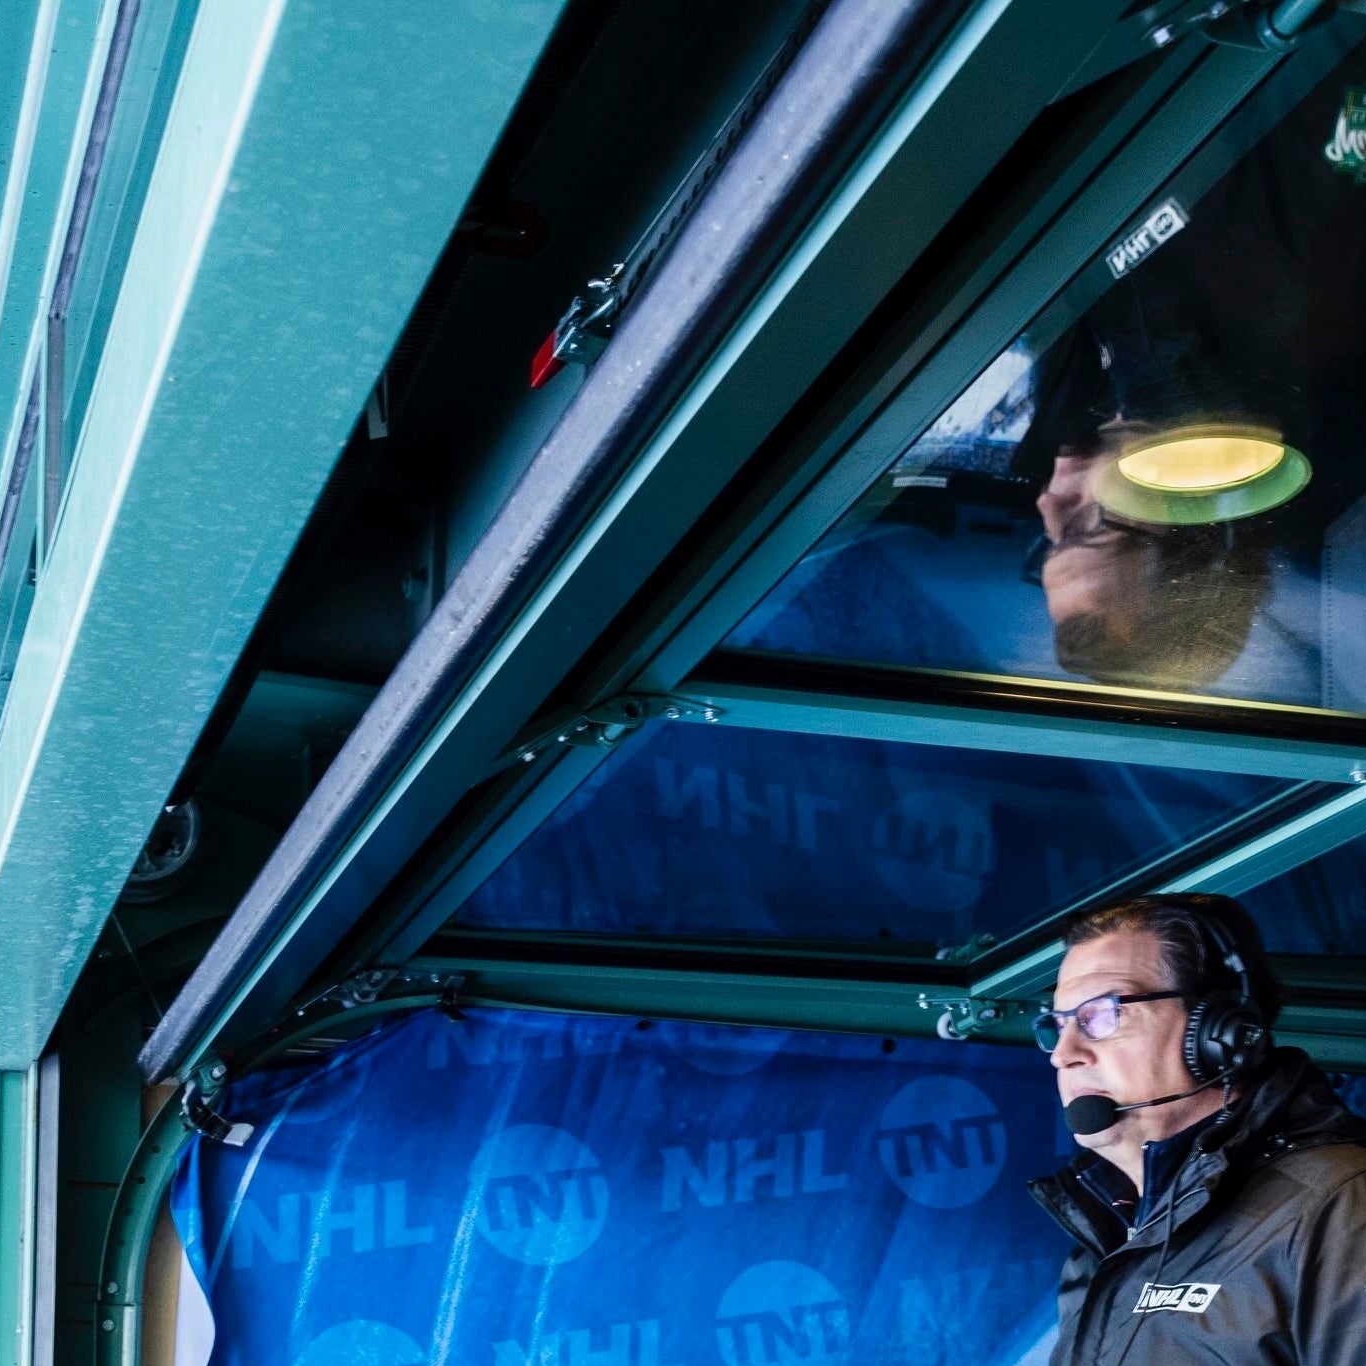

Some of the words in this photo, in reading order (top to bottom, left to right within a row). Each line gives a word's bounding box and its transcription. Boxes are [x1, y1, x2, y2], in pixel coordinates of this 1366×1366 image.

[662, 1129, 849, 1213] NHL
[879, 1112, 1007, 1180] TNT
[234, 1179, 434, 1270] NHL
[485, 1170, 608, 1236] TNT
[1141, 1287, 1185, 1308] NHL
